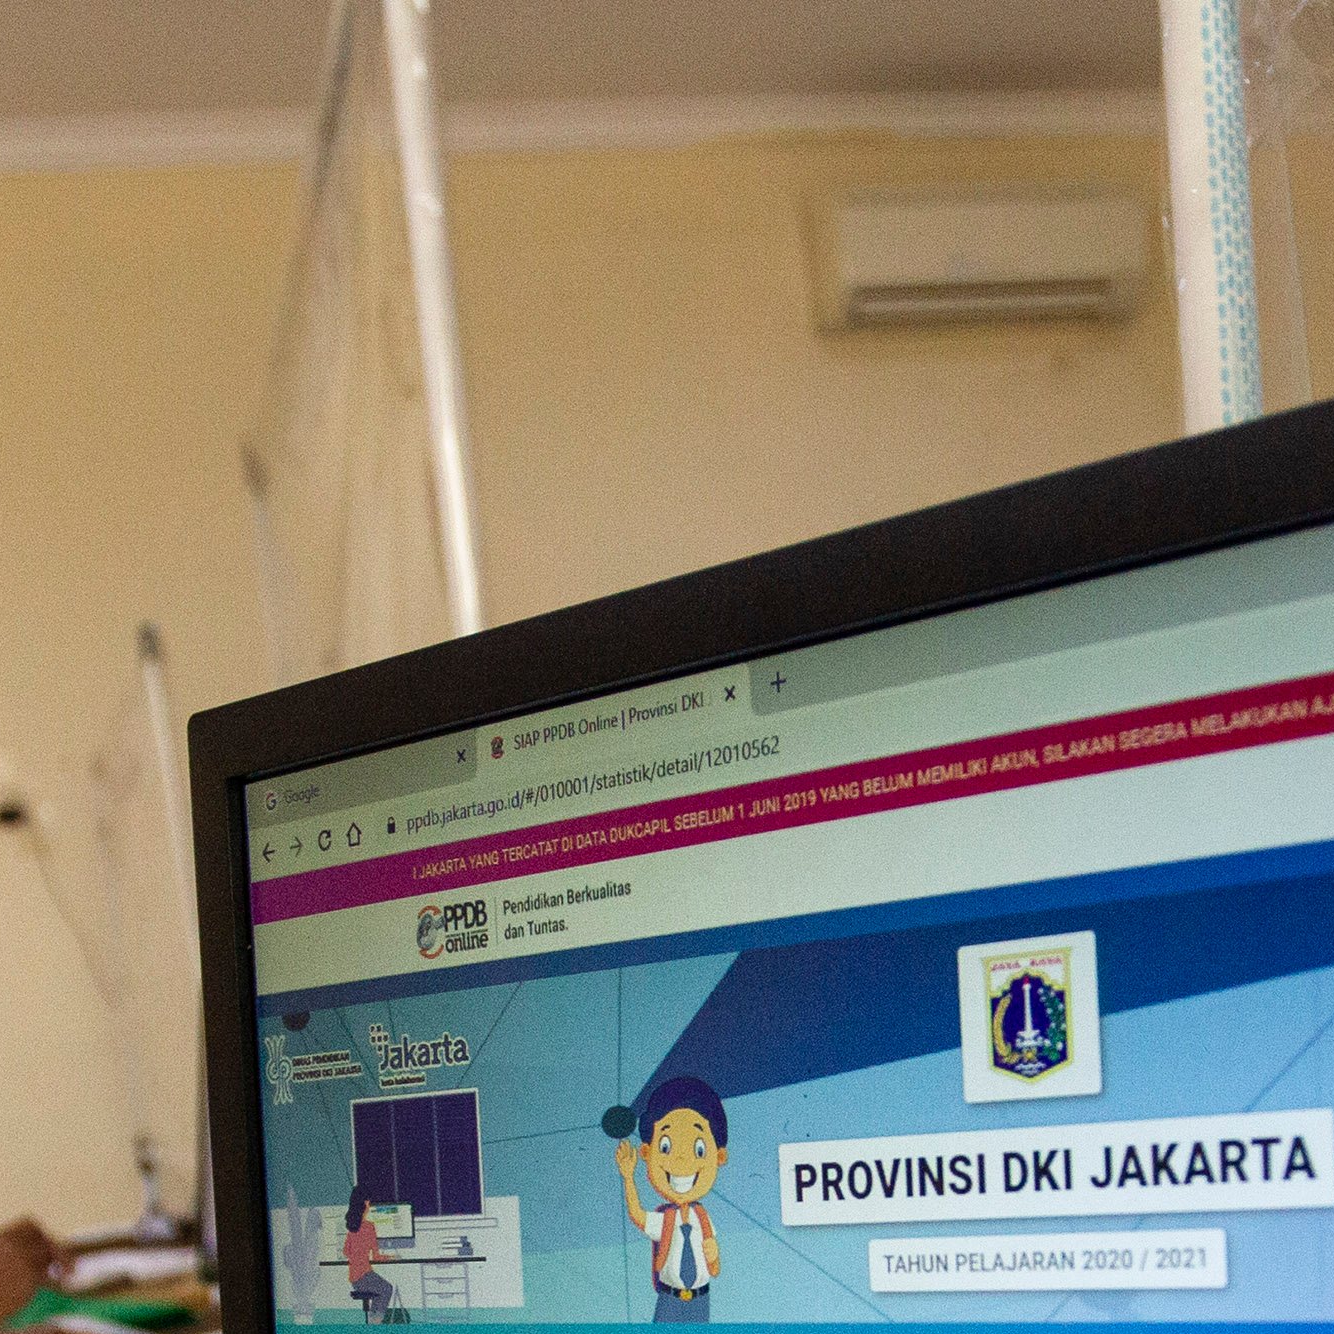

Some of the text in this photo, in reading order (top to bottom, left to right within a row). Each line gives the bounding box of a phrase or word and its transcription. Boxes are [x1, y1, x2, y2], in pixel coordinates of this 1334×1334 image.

[513, 730, 540, 751] SIAP
[543, 722, 576, 744] PPDB
[578, 714, 618, 735] Online
[628, 701, 678, 724] Provinsi
[681, 691, 705, 712] DKI
[283, 784, 321, 805] Google
[419, 858, 467, 880] JAKARTA
[468, 850, 499, 869] YANG
[502, 838, 560, 864] TERCATAT
[561, 836, 574, 853] DI
[576, 829, 607, 851] DATA
[609, 817, 672, 846] DUKCAPIL
[673, 806, 735, 831] SEBELUM
[748, 797, 781, 819] JUNI
[784, 790, 817, 812] 2019
[819, 780, 860, 804] YANG
[862, 771, 914, 798] BELUM
[916, 755, 989, 787] MEMILIKI
[1042, 734, 1116, 764] SILAKAN
[1189, 699, 1310, 737] MELAKUKAN
[502, 880, 632, 916] Pendidikan Berkualitas
[443, 899, 488, 932] PPDB
[504, 922, 525, 940] dan
[445, 931, 489, 954] online
[380, 1034, 470, 1071] Jakarta
[794, 1135, 1318, 1203] PROVINSI DKI JAKARTA
[882, 1250, 950, 1275] TAHUN
[955, 1249, 1076, 1275] PELAJARAN
[1081, 1247, 1134, 1272] 2020
[1155, 1246, 1208, 1270] 2021
